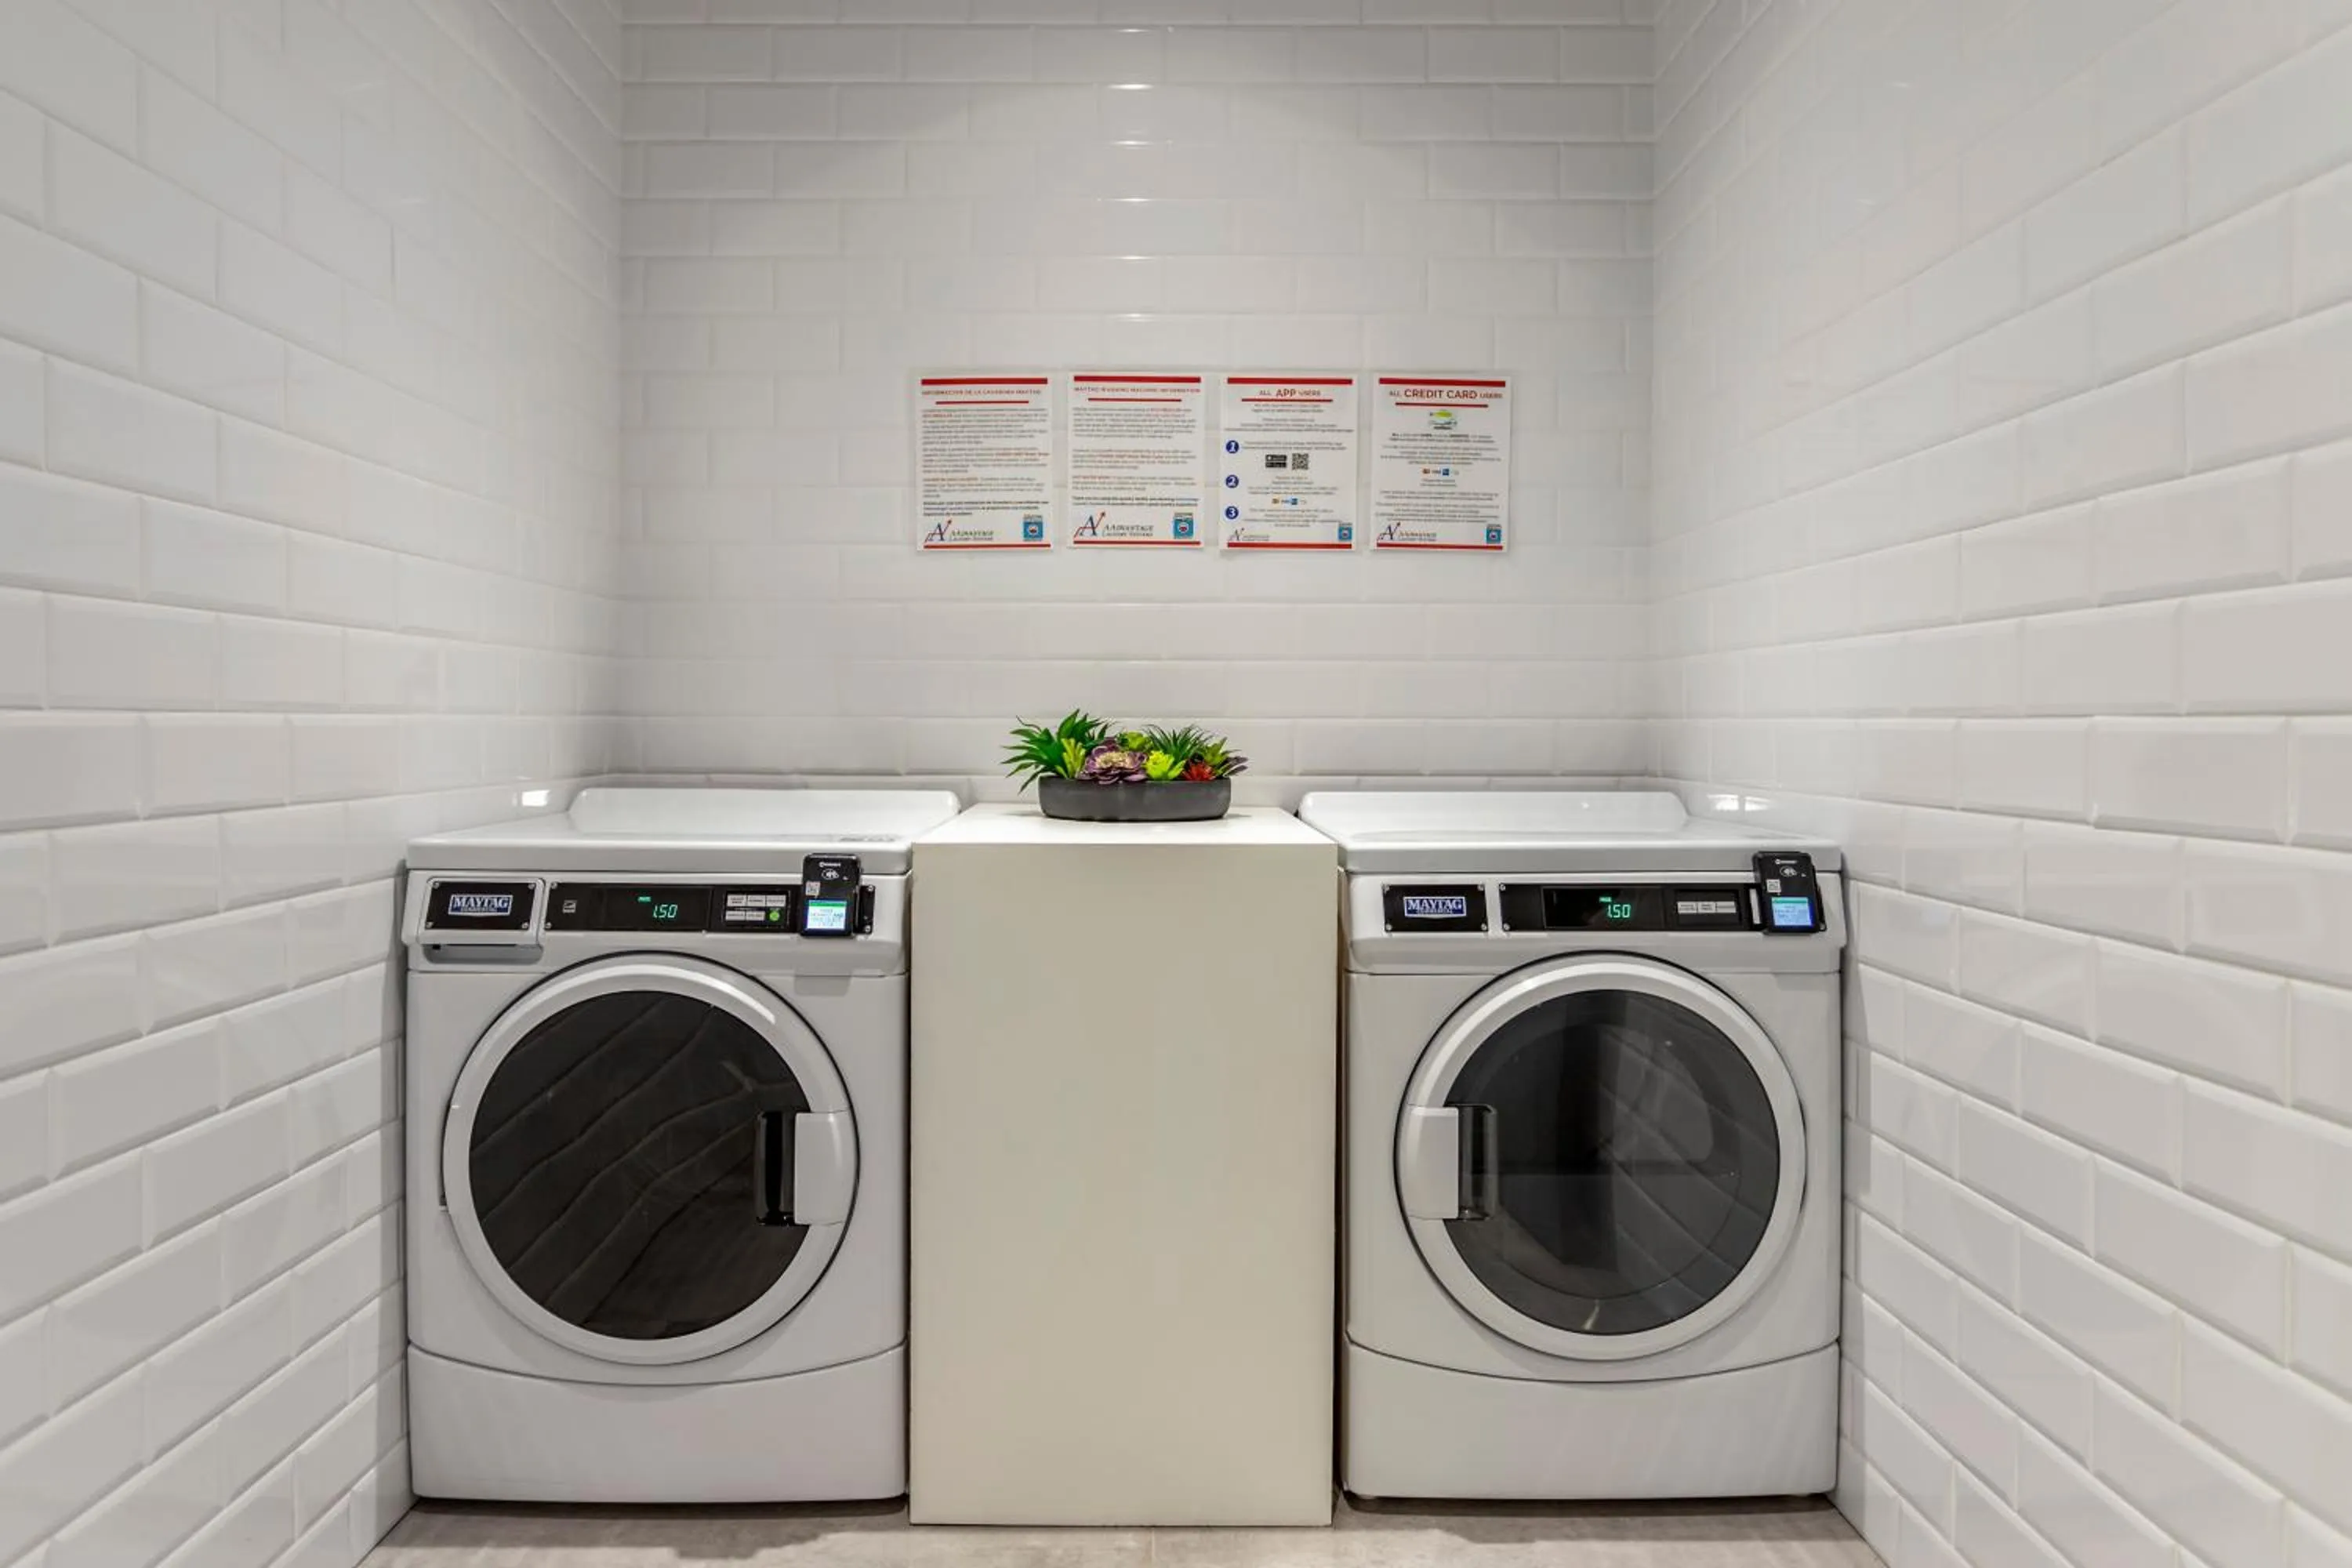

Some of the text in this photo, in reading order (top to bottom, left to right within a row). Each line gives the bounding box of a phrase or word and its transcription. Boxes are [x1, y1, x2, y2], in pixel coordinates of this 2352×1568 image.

[1276, 388, 1296, 397] APP
[1404, 389, 1443, 399] CREDIT
[1446, 389, 1478, 399] CARD
[453, 897, 509, 909] MAYTAG
[1407, 899, 1462, 910] MAYTAG
